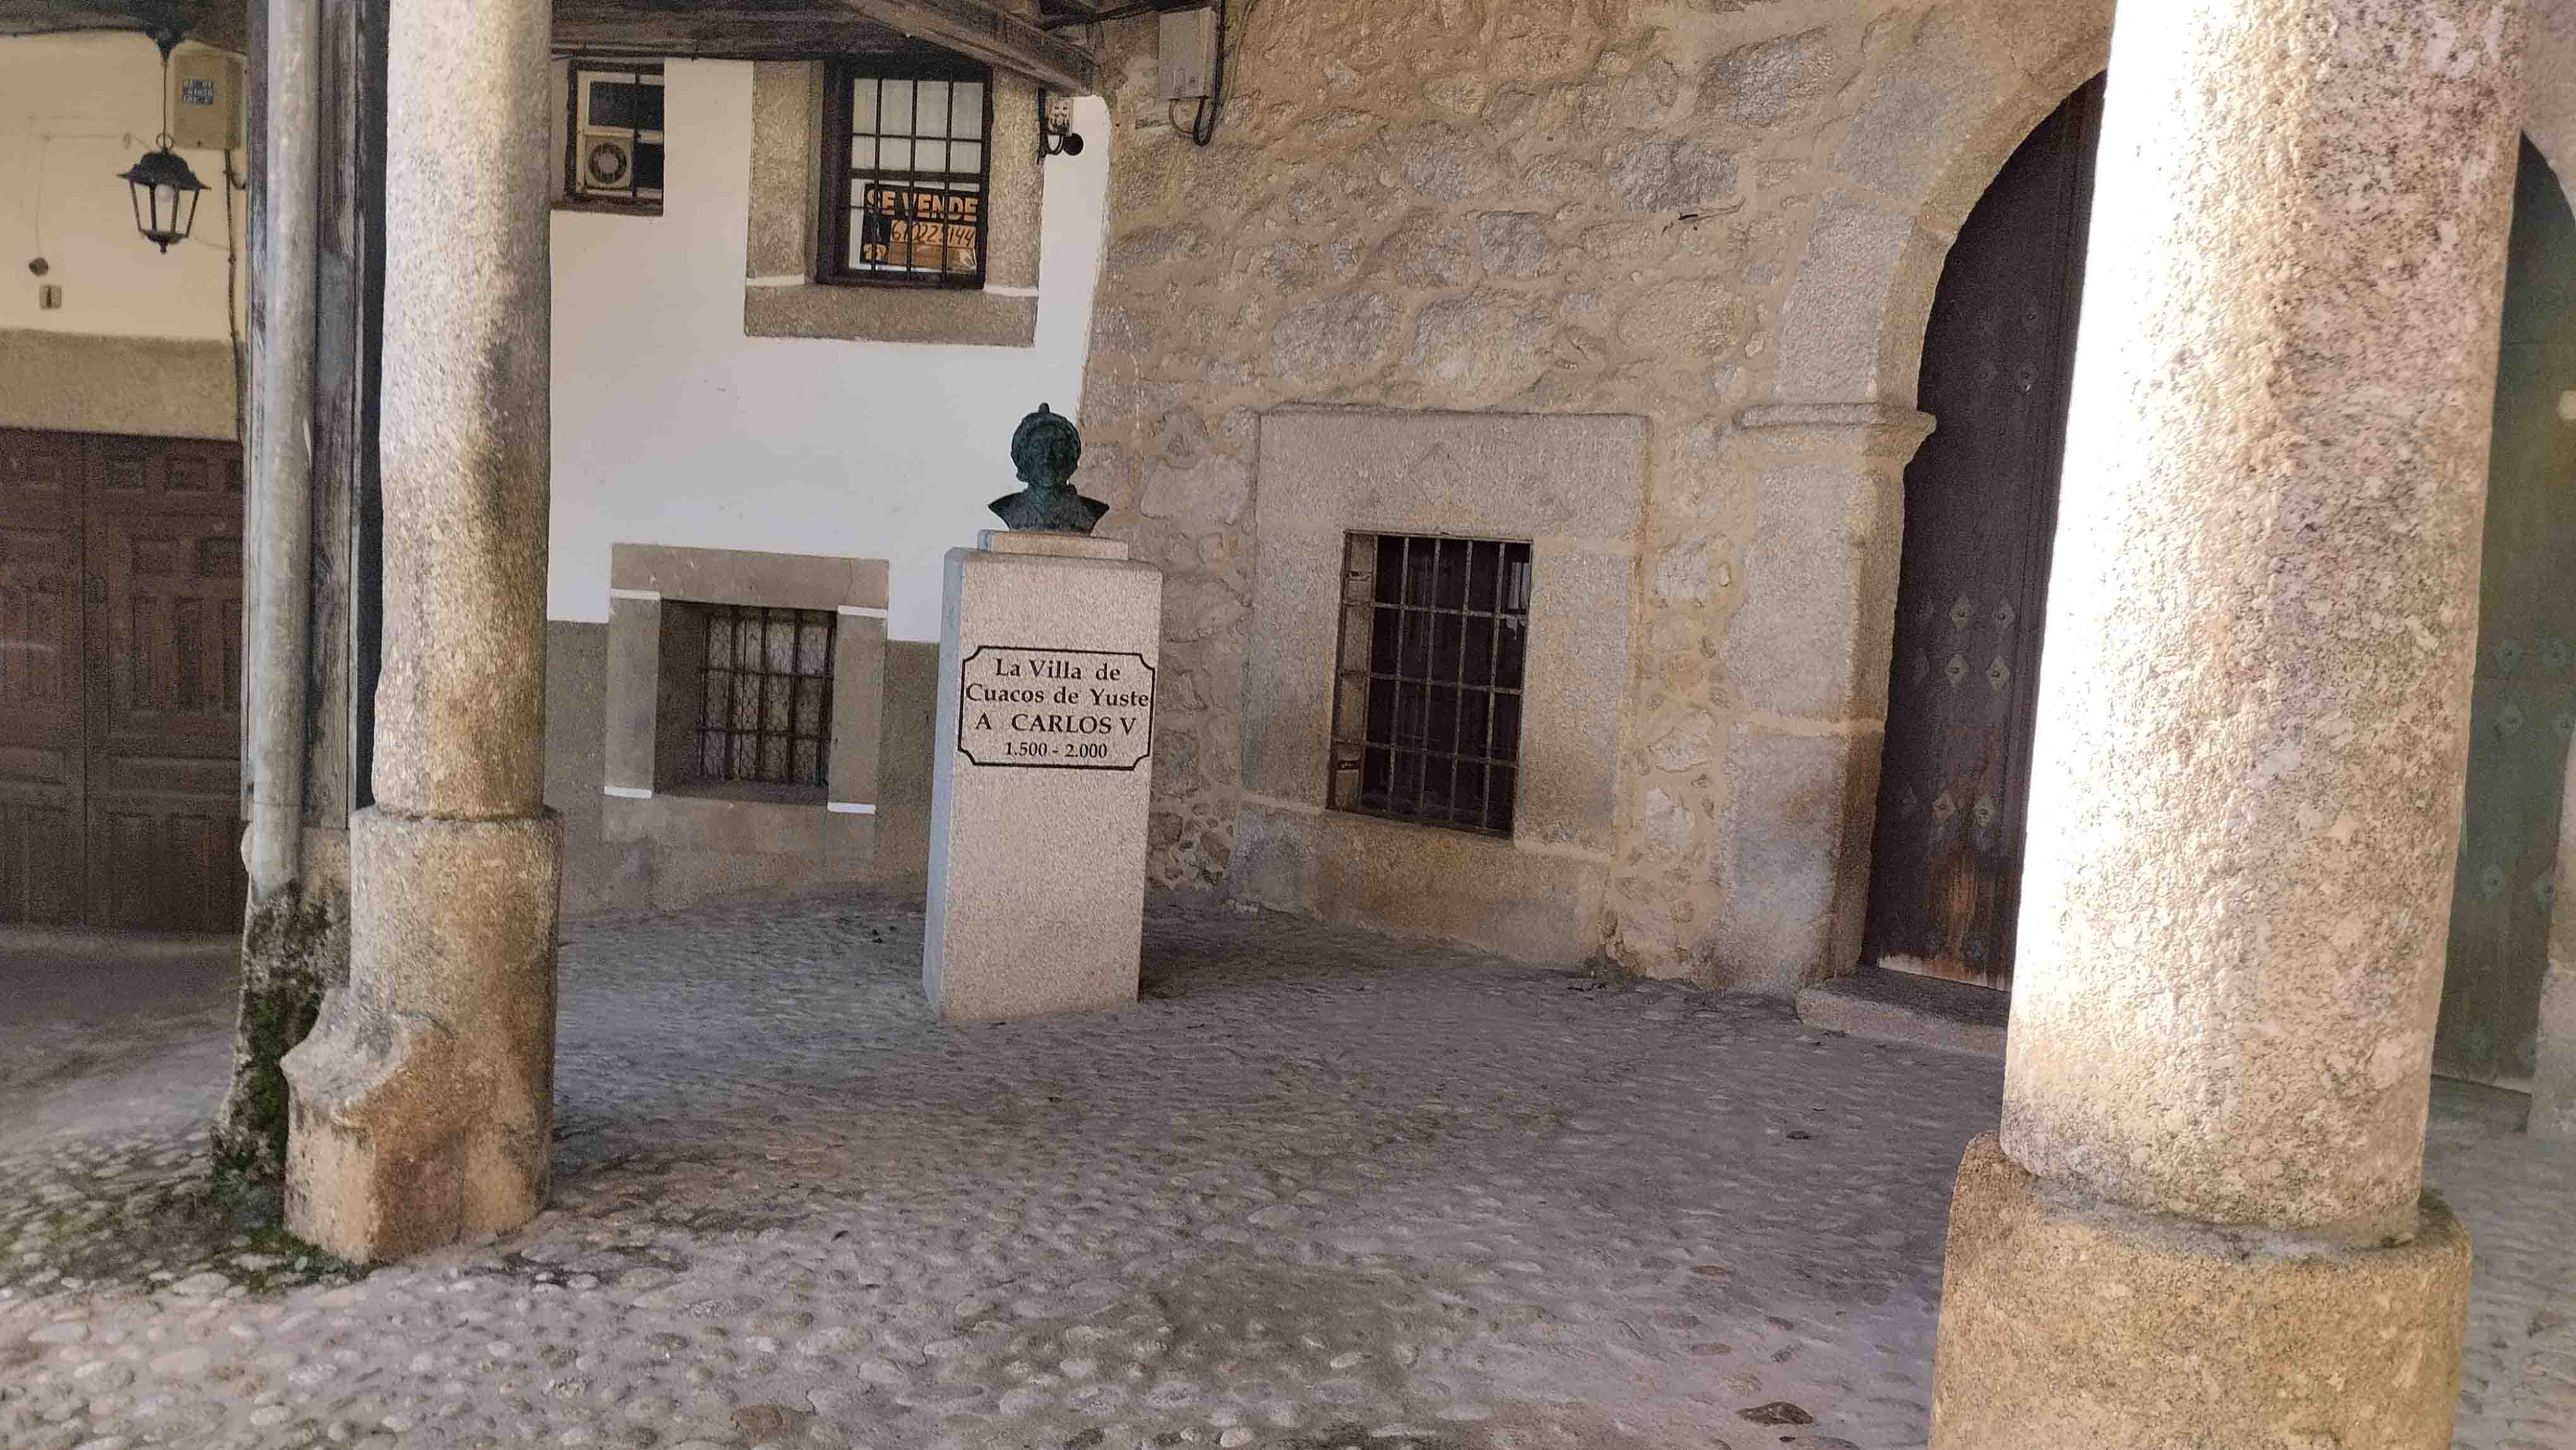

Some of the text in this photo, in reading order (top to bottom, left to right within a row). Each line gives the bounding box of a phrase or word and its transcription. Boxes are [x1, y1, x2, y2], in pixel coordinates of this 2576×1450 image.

[902, 191, 979, 222] VENDE
[996, 658, 1120, 681] La Villa de
[966, 683, 1148, 707] Cuacos de Yuste
[976, 712, 1136, 735] A CARLOS V
[1005, 742, 1047, 757] 1.500
[1064, 744, 1107, 758] 2.000
